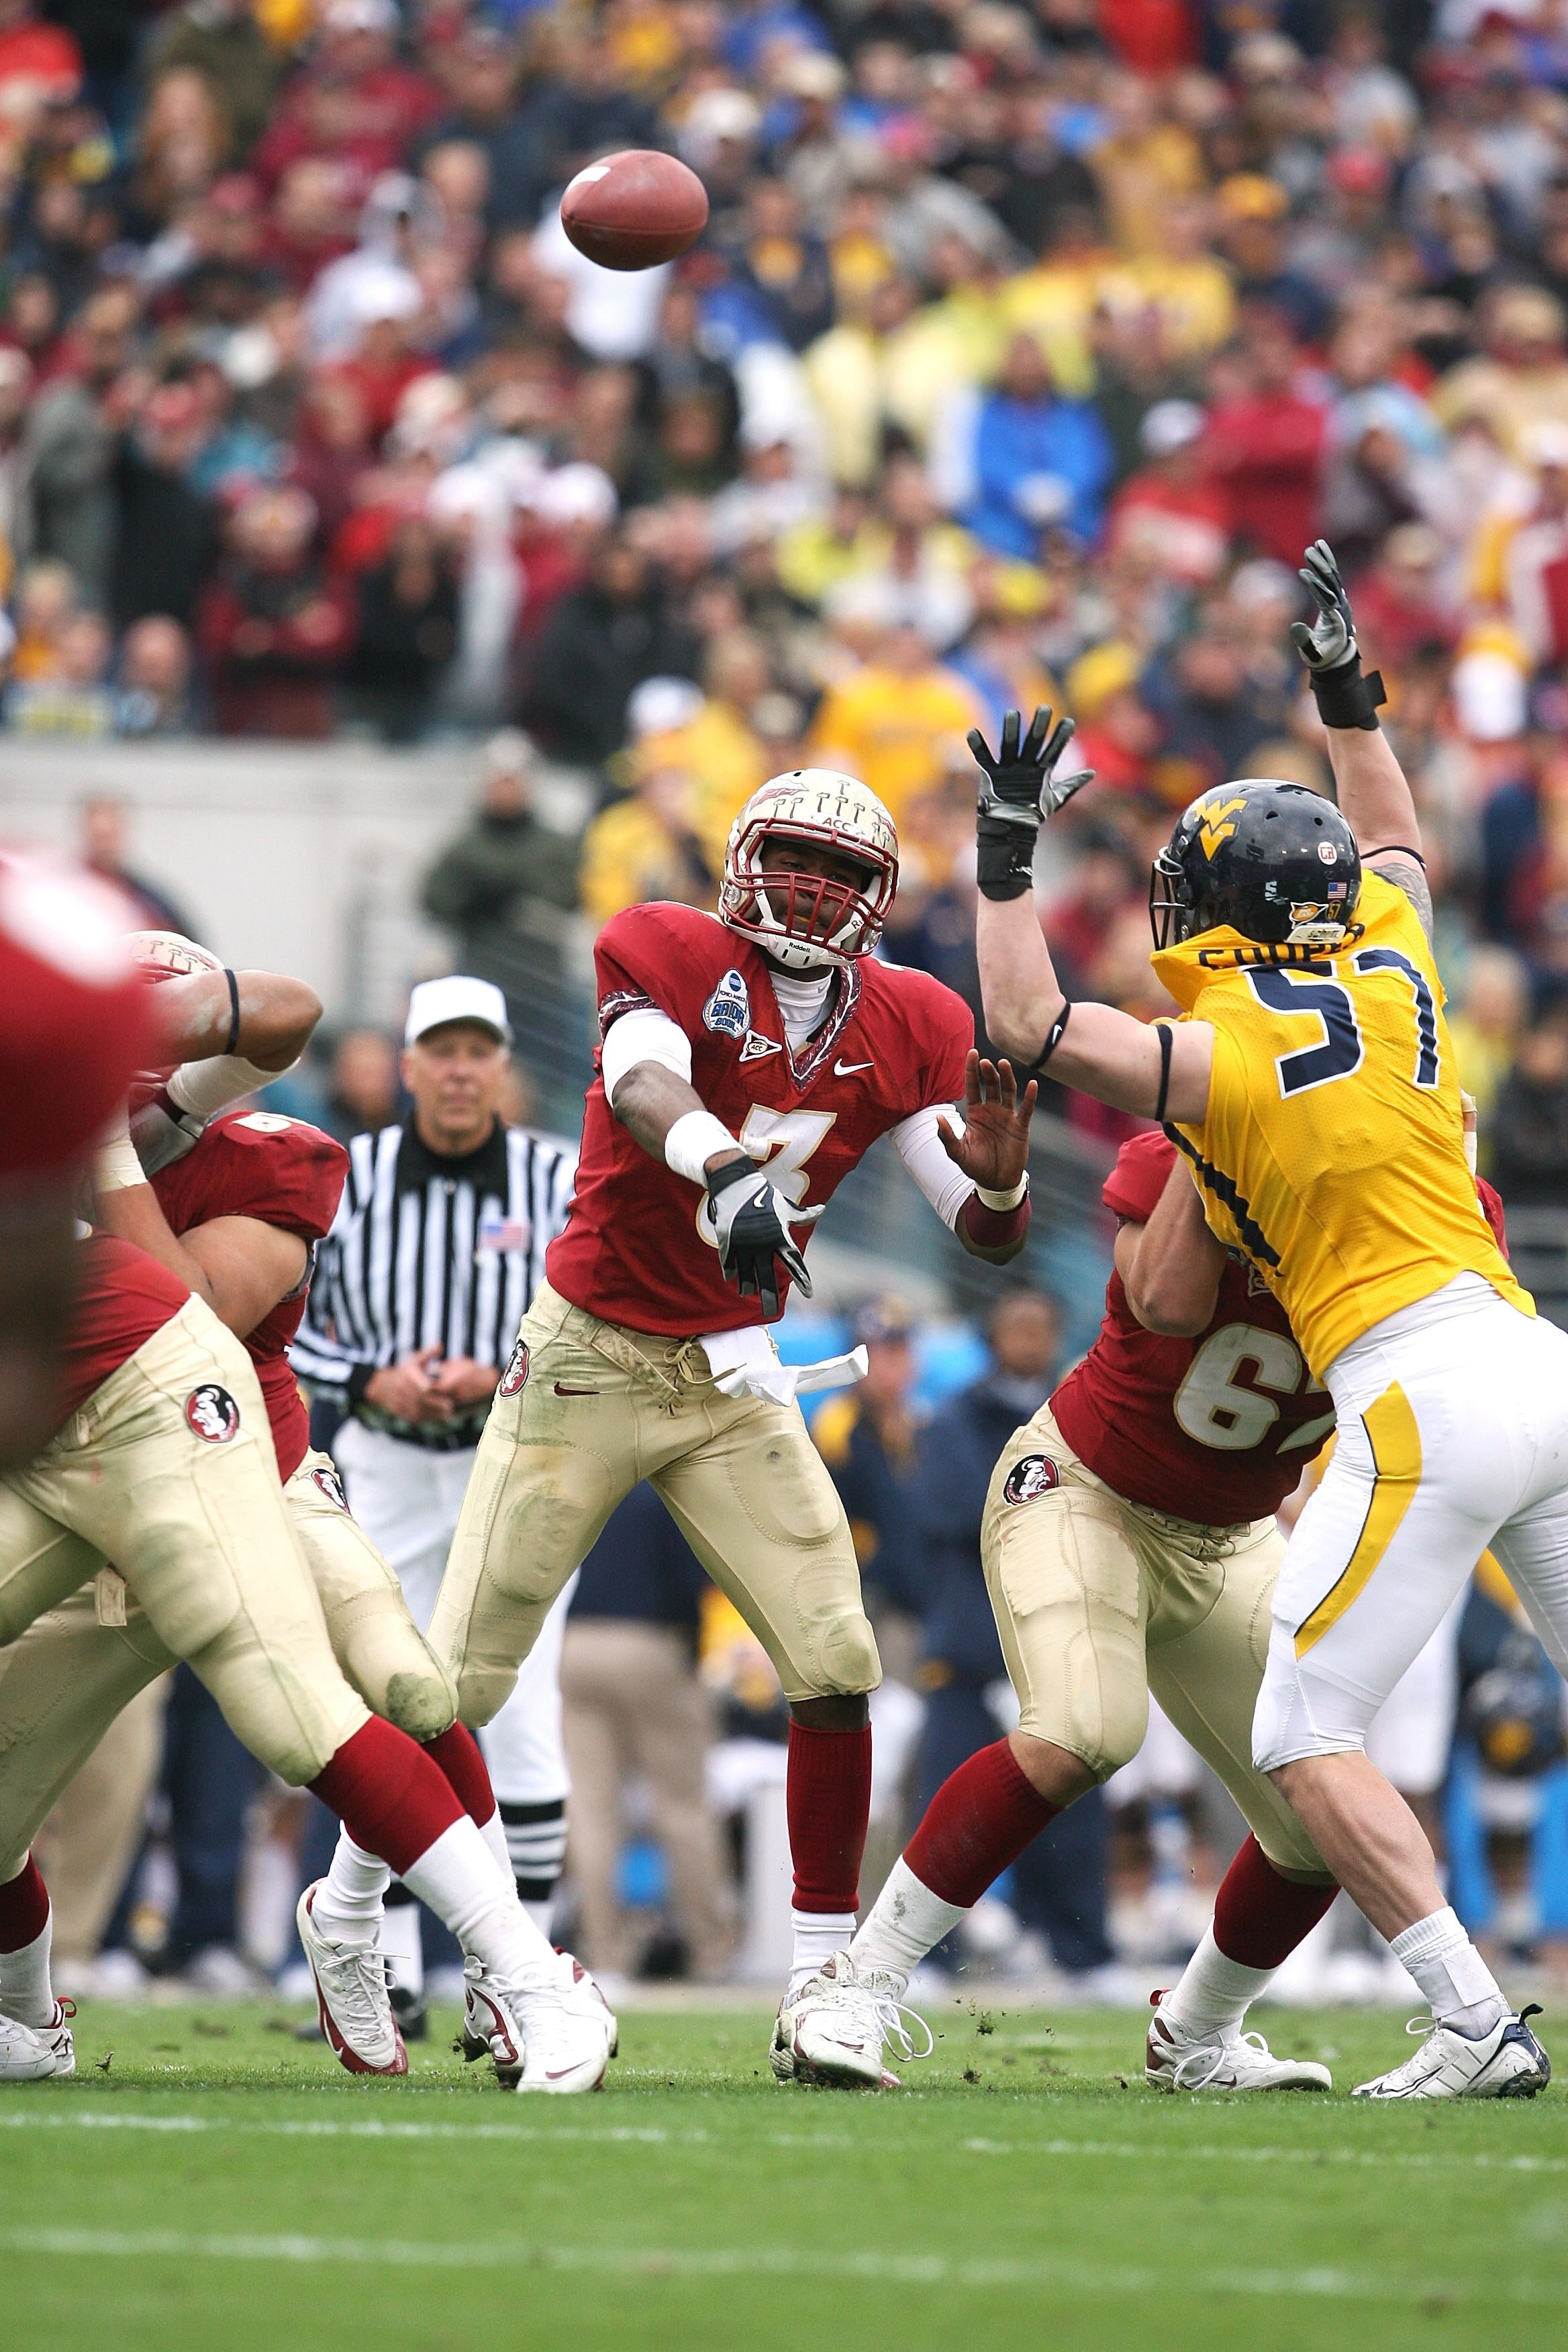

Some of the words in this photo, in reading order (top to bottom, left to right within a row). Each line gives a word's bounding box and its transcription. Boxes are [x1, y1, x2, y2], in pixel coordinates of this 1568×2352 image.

[822, 817, 851, 832] ACC
[788, 941, 812, 953] Riddell
[1238, 946, 1441, 1100] 57
